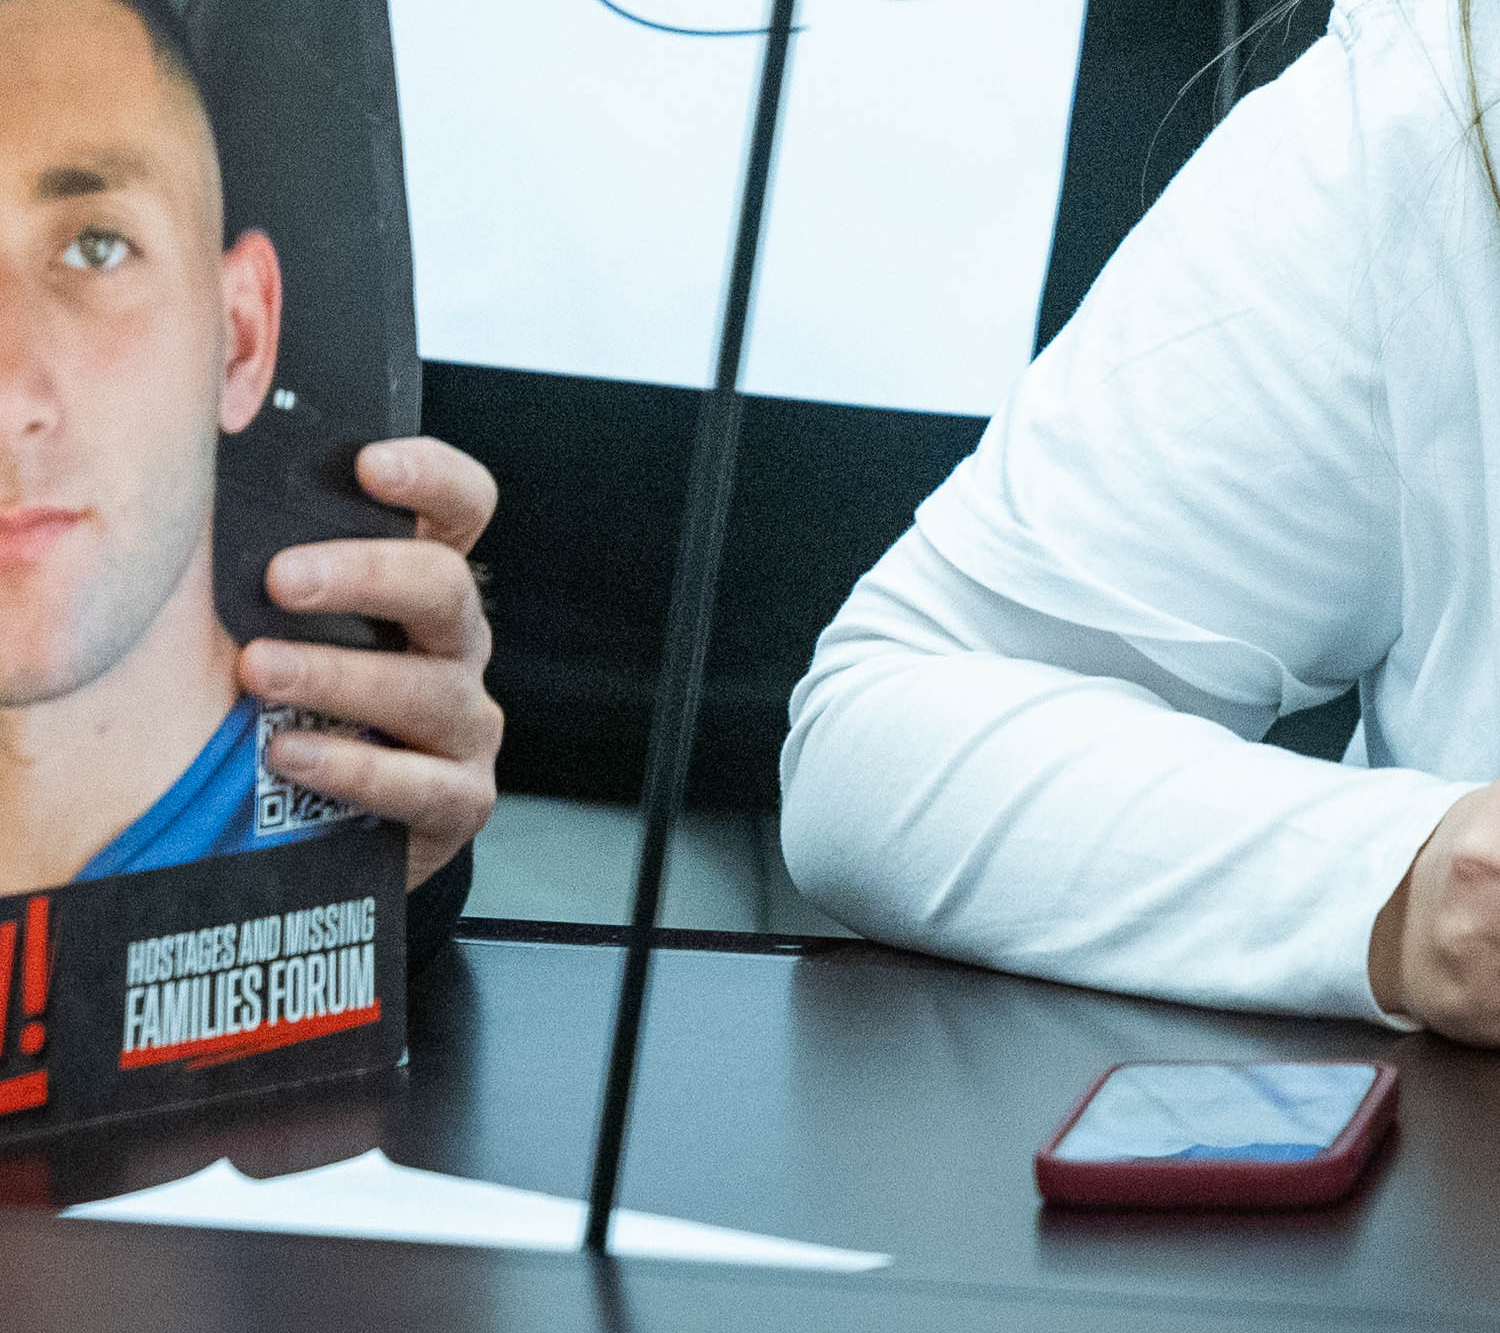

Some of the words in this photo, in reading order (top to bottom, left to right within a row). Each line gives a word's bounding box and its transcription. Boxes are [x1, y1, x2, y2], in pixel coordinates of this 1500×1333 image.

[126, 922, 238, 988] HOSTAGES
[237, 914, 283, 967] AND
[283, 895, 377, 958] MISSING
[122, 964, 264, 1054] FAMILIES
[267, 941, 376, 1027] FORUM
